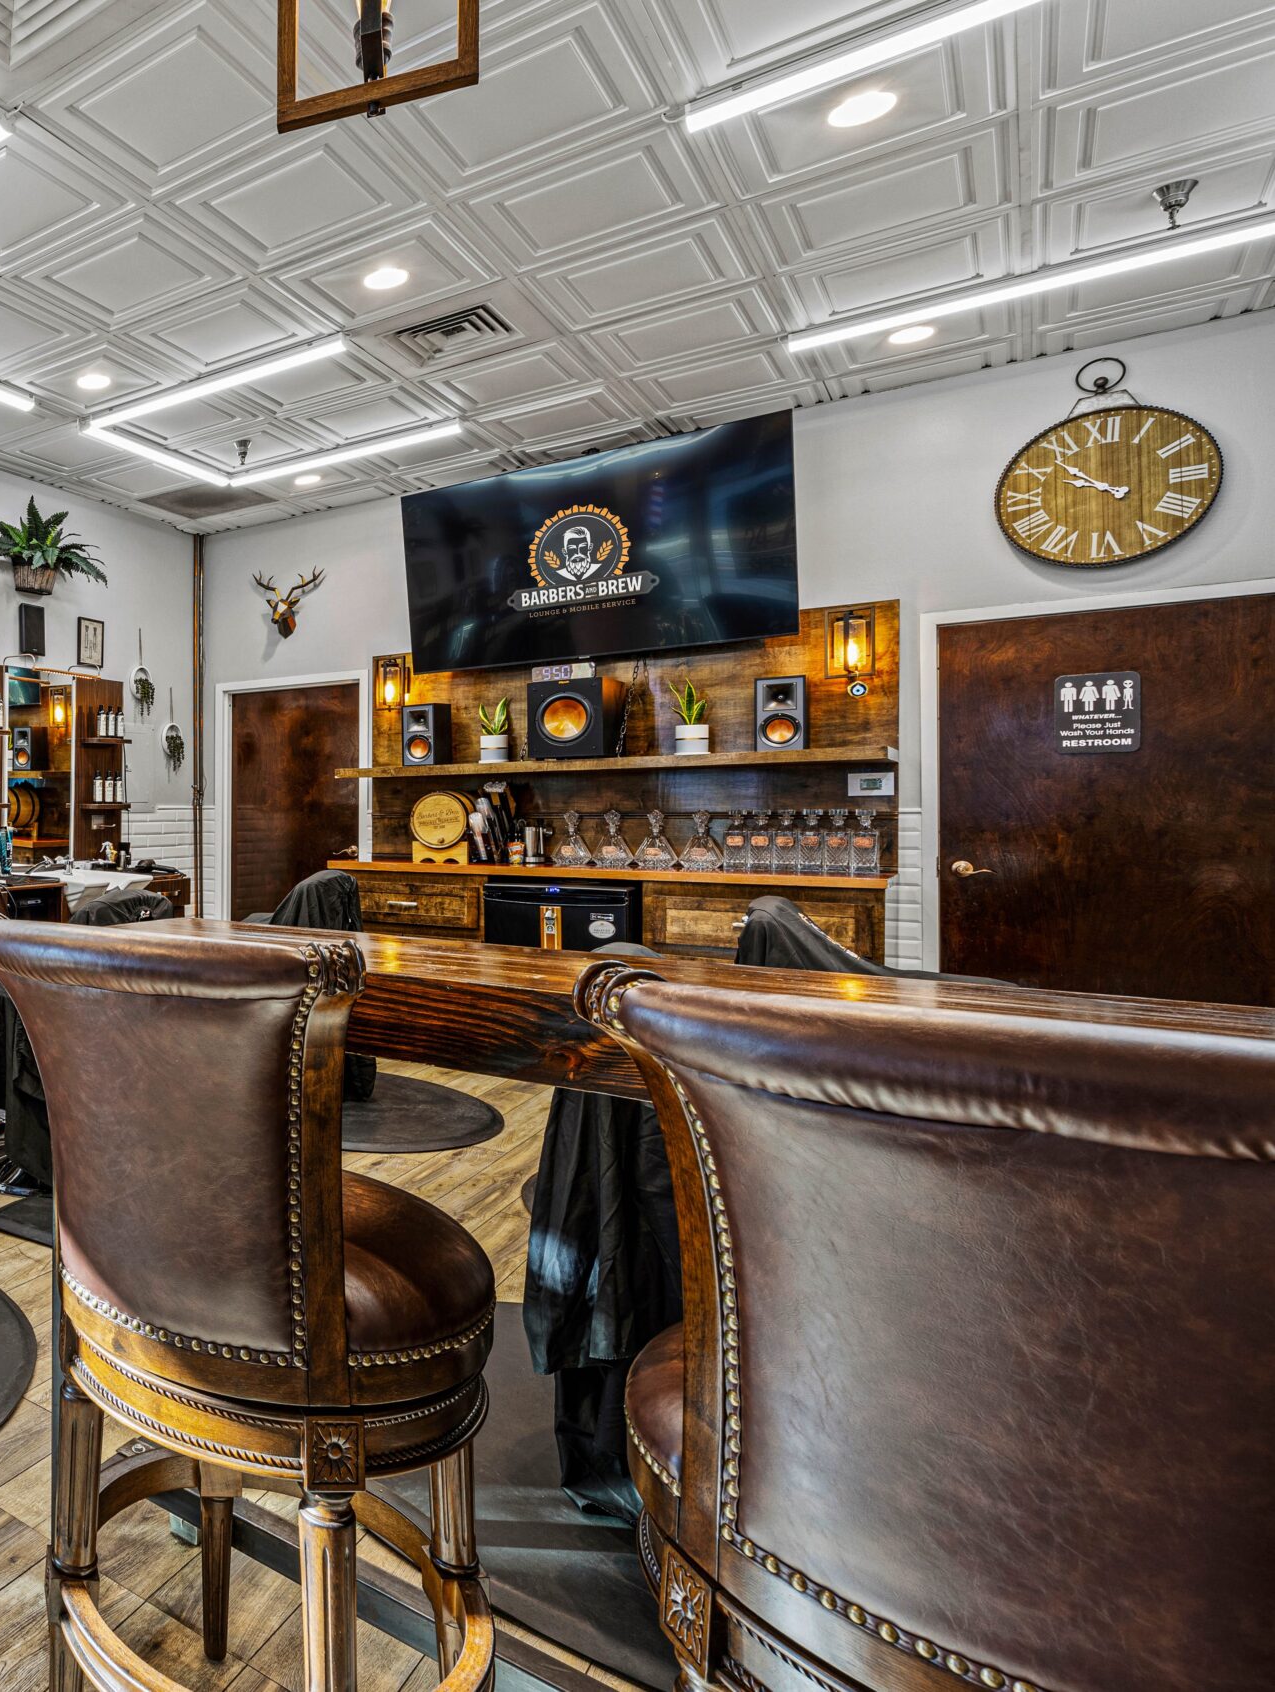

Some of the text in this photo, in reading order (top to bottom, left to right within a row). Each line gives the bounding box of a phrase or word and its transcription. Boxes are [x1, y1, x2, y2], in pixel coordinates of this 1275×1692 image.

[521, 584, 584, 607] BARBERS
[598, 575, 643, 597] BREW
[529, 608, 561, 618] LOUNGE
[570, 603, 600, 613] MOBILE
[602, 598, 637, 609] SERVICE
[1072, 713, 1123, 721] WHATEVER...
[1103, 721, 1121, 729] Just
[1062, 738, 1132, 748] RESTROOM
